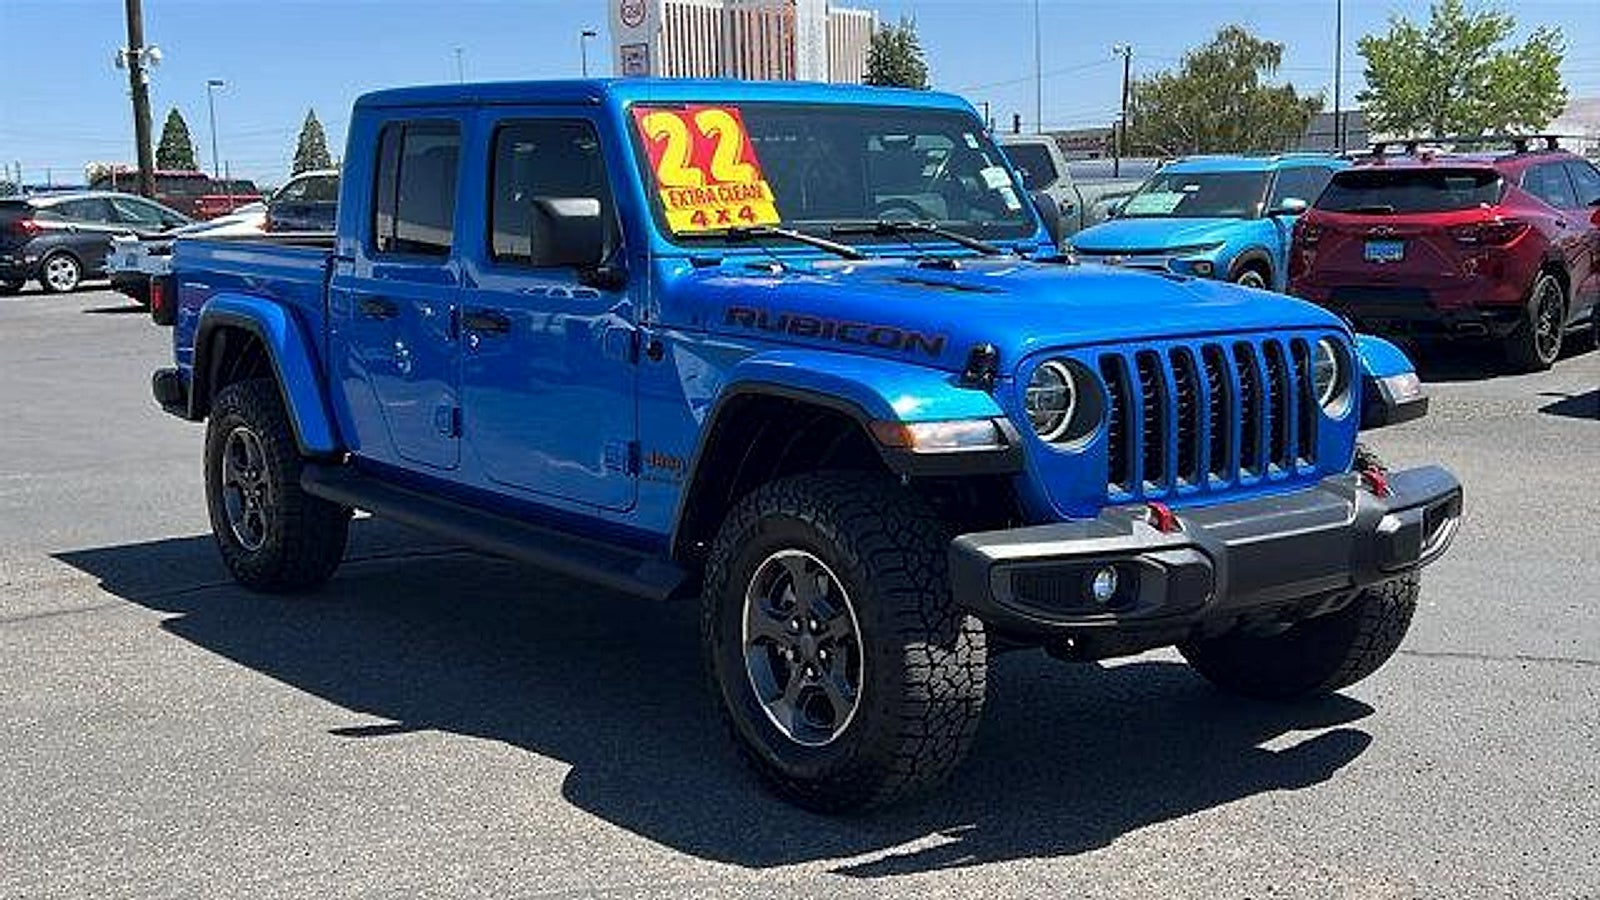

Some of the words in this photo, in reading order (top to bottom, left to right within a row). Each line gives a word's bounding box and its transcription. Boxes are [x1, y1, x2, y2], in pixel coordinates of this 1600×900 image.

[642, 109, 760, 187] 22
[669, 186, 718, 208] EXTRA
[718, 183, 765, 204] CLEAN
[725, 305, 947, 356] RUBICON
